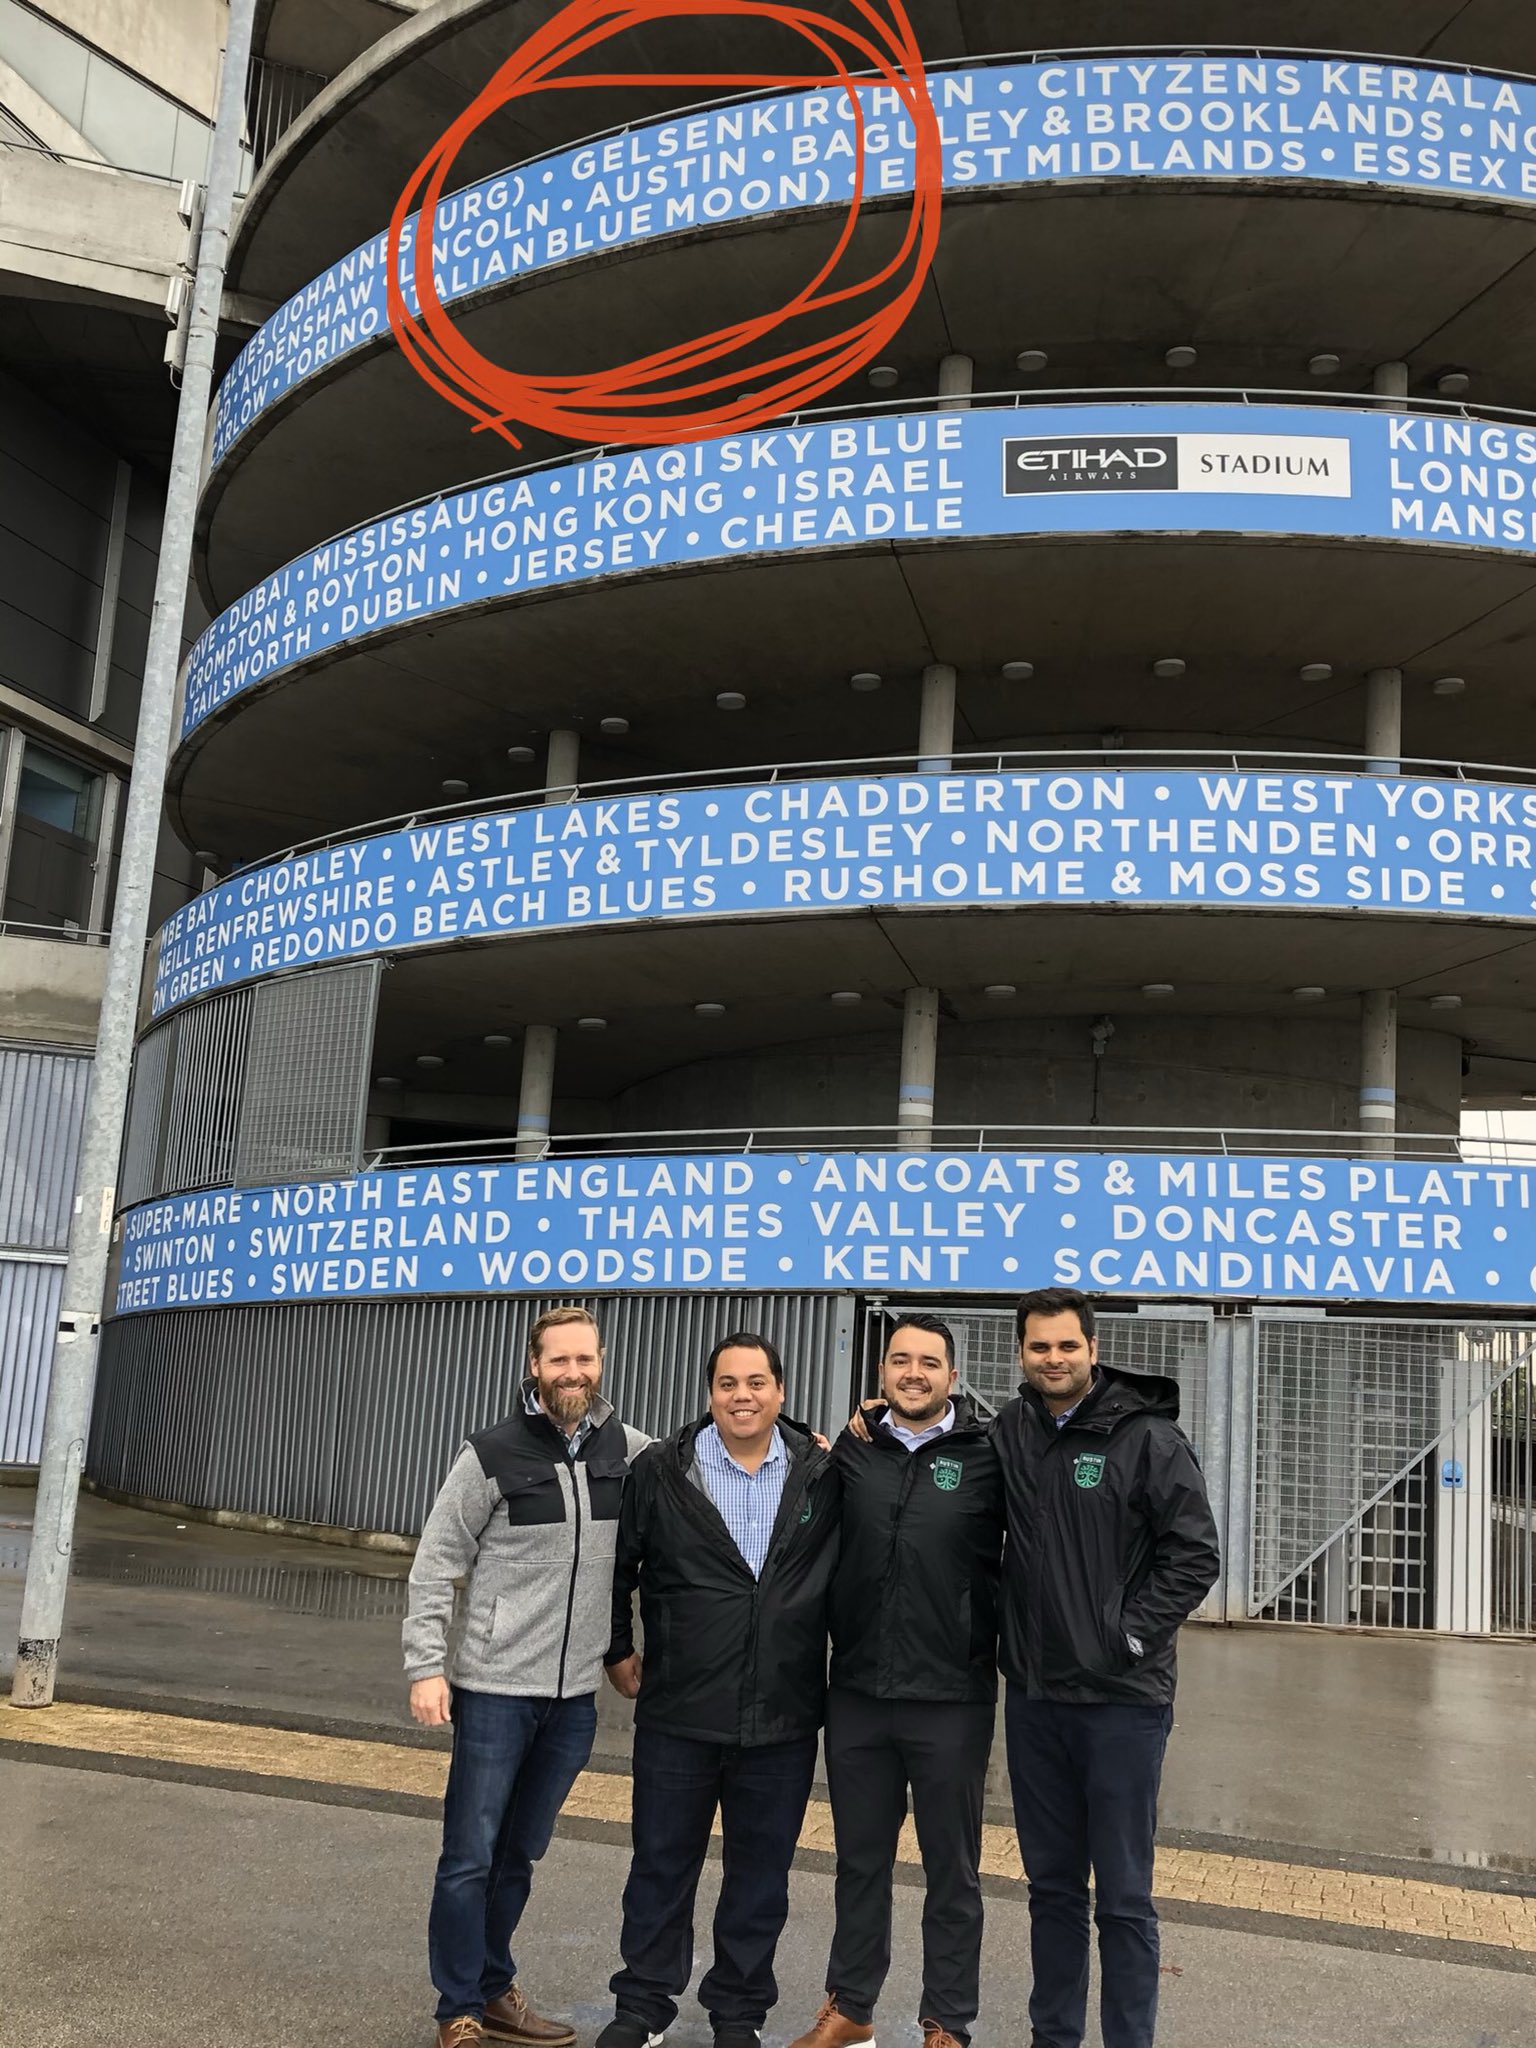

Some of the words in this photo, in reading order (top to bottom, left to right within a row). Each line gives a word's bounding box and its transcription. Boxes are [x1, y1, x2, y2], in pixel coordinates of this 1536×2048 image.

[223, 328, 266, 399] BLUES
[271, 175, 525, 343] (JOHANNESURG)
[1037, 63, 1301, 99] CITYZENS
[1322, 64, 1522, 116] KERALA
[240, 274, 374, 401] AUDENSHAW
[400, 198, 549, 285] LNCOLN
[585, 146, 746, 213] AUSTIN
[791, 107, 1029, 166] BAGULEY
[1042, 104, 1071, 136] &
[1086, 100, 1444, 142] BROOKLANDS
[285, 306, 379, 385] TORINO
[546, 203, 652, 260] BLUE
[665, 170, 831, 227] MOON)
[880, 147, 1012, 189] EST
[1027, 140, 1305, 176] MIDLANDS
[1354, 142, 1506, 189] ESSEX
[228, 570, 290, 633] DUBAI
[312, 479, 535, 581] MISSISSAUGA
[577, 446, 703, 497] IRAQI
[720, 431, 816, 472] SKY
[831, 418, 963, 460] BLUE
[1390, 418, 1536, 465] KINGS
[1016, 447, 1168, 471] ETIHAD
[1200, 452, 1331, 477] STADIUM
[1048, 471, 1138, 482] AIRWAYS
[189, 610, 277, 700] CROMPTON
[283, 599, 297, 628] &
[305, 544, 426, 617] ROYTON
[464, 506, 578, 560] HONG
[594, 481, 723, 533] KONG
[777, 458, 963, 503] ISRAEL
[1391, 458, 1536, 501] LOND
[191, 623, 311, 725] FAILSWORTH
[341, 569, 460, 634] DUBLIN
[503, 527, 667, 586] JERSEY
[720, 497, 963, 549] CHEADLE
[1392, 499, 1536, 544] MANS
[186, 892, 220, 933] BAY
[241, 845, 368, 907] CHORLEY
[409, 817, 516, 863] WEST
[535, 798, 681, 844] LAKES
[745, 777, 1125, 824] CHADDERTON
[1197, 777, 1354, 814] WEST
[195, 875, 395, 959] RENFREWSHIRE
[427, 847, 584, 897] ASTLEY
[596, 842, 621, 876] &
[635, 821, 934, 872] TYLDESLEY
[987, 818, 1376, 858] NORTHENDEN
[1429, 829, 1532, 869] ORR
[170, 955, 225, 1002] GREEN
[251, 912, 397, 971] REDONDO
[413, 888, 545, 937] BEACH
[567, 874, 716, 918] BLUES
[784, 861, 1084, 902] RUSHOLME
[1111, 860, 1142, 895] &
[1170, 861, 1320, 899] MOSS
[1347, 865, 1465, 906] SIDE
[124, 1194, 242, 1244] -SUPER-MARE
[270, 1177, 382, 1219] NORTH
[396, 1170, 500, 1207] EAST
[516, 1161, 754, 1200] ENGLAND
[813, 1158, 1081, 1194] ANCOATS
[1104, 1159, 1135, 1195] &
[1160, 1160, 1326, 1201] MILES
[1349, 1167, 1530, 1209] PLATTI
[134, 1233, 216, 1273] SWINTON
[248, 1211, 511, 1259] SWITZERLAND
[578, 1202, 783, 1240] THAMES
[809, 1203, 1026, 1237] VALLEY
[1113, 1204, 1463, 1250] DONCASTER
[167, 1267, 234, 1303] BLUES
[271, 1255, 419, 1294] SWEDEN
[479, 1247, 747, 1285] WOODSIDE
[823, 1245, 969, 1282] KENT
[1053, 1247, 1456, 1295] SCANDINAVIA
